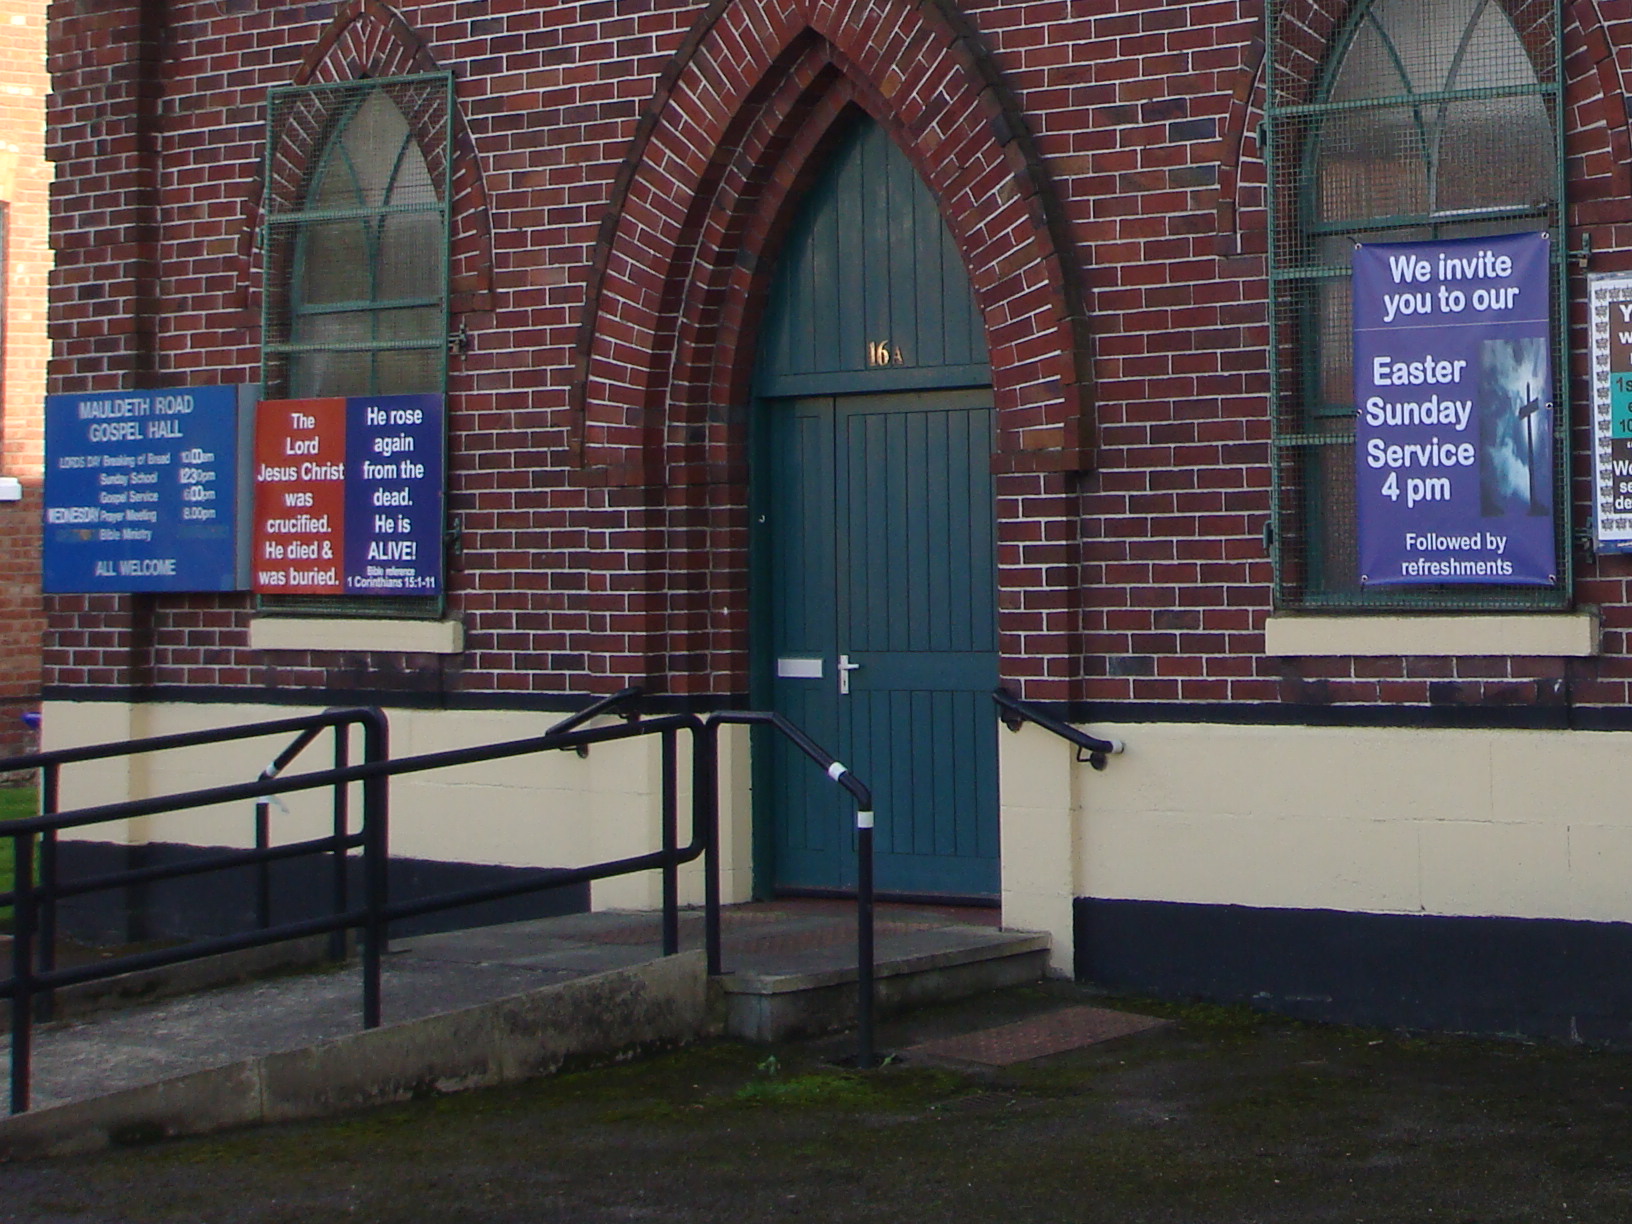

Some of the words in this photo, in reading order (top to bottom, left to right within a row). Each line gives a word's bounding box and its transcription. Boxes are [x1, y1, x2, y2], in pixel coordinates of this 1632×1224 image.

[1389, 255, 1431, 284] We
[1438, 250, 1513, 281] invite
[1383, 291, 1432, 322] you
[1438, 285, 1466, 314] to
[1472, 285, 1520, 310] our
[1373, 355, 1466, 387] Easter
[78, 399, 151, 420] MAULDETH
[155, 396, 194, 414] ROAD
[367, 408, 387, 427] He
[390, 408, 423, 425] rose
[1365, 395, 1473, 431] Sunday
[291, 413, 316, 429] The
[89, 422, 144, 442] GOSPEL
[148, 420, 183, 438] HALL
[286, 436, 319, 455] Lord
[374, 435, 415, 455] again
[1367, 438, 1476, 469] Service
[103, 455, 136, 468] Breaking
[137, 454, 145, 464] of
[147, 453, 170, 464] Bread
[364, 461, 397, 479] from
[400, 461, 424, 479] the
[100, 473, 128, 486] Sunday
[130, 472, 158, 484] School
[258, 463, 298, 482] Jesus
[301, 462, 345, 480] Christ
[100, 492, 127, 504] Gospel
[129, 491, 158, 502] Service
[285, 491, 313, 507] was
[373, 488, 413, 506] dead.
[1381, 471, 1400, 502] 4
[1407, 477, 1451, 509] pm
[100, 511, 125, 522] Prayer
[126, 509, 157, 522] Meeting
[267, 515, 332, 534] crucified.
[375, 516, 395, 533] He
[398, 515, 411, 532] is
[99, 529, 121, 540] Bible
[122, 528, 152, 541] Ministry
[1406, 532, 1482, 551] Followed
[1486, 533, 1507, 553] by
[265, 541, 285, 559] He
[287, 539, 318, 559] died
[322, 541, 333, 557] &
[368, 541, 417, 560] ALIVE!
[95, 561, 116, 576] ALL
[119, 559, 177, 576] WELCOME
[1402, 556, 1513, 576] refreshments
[259, 570, 287, 585] was
[290, 566, 340, 586] buried.
[348, 577, 352, 587] 1
[355, 576, 403, 587] Corinthians
[405, 577, 435, 588] 15:1-11
